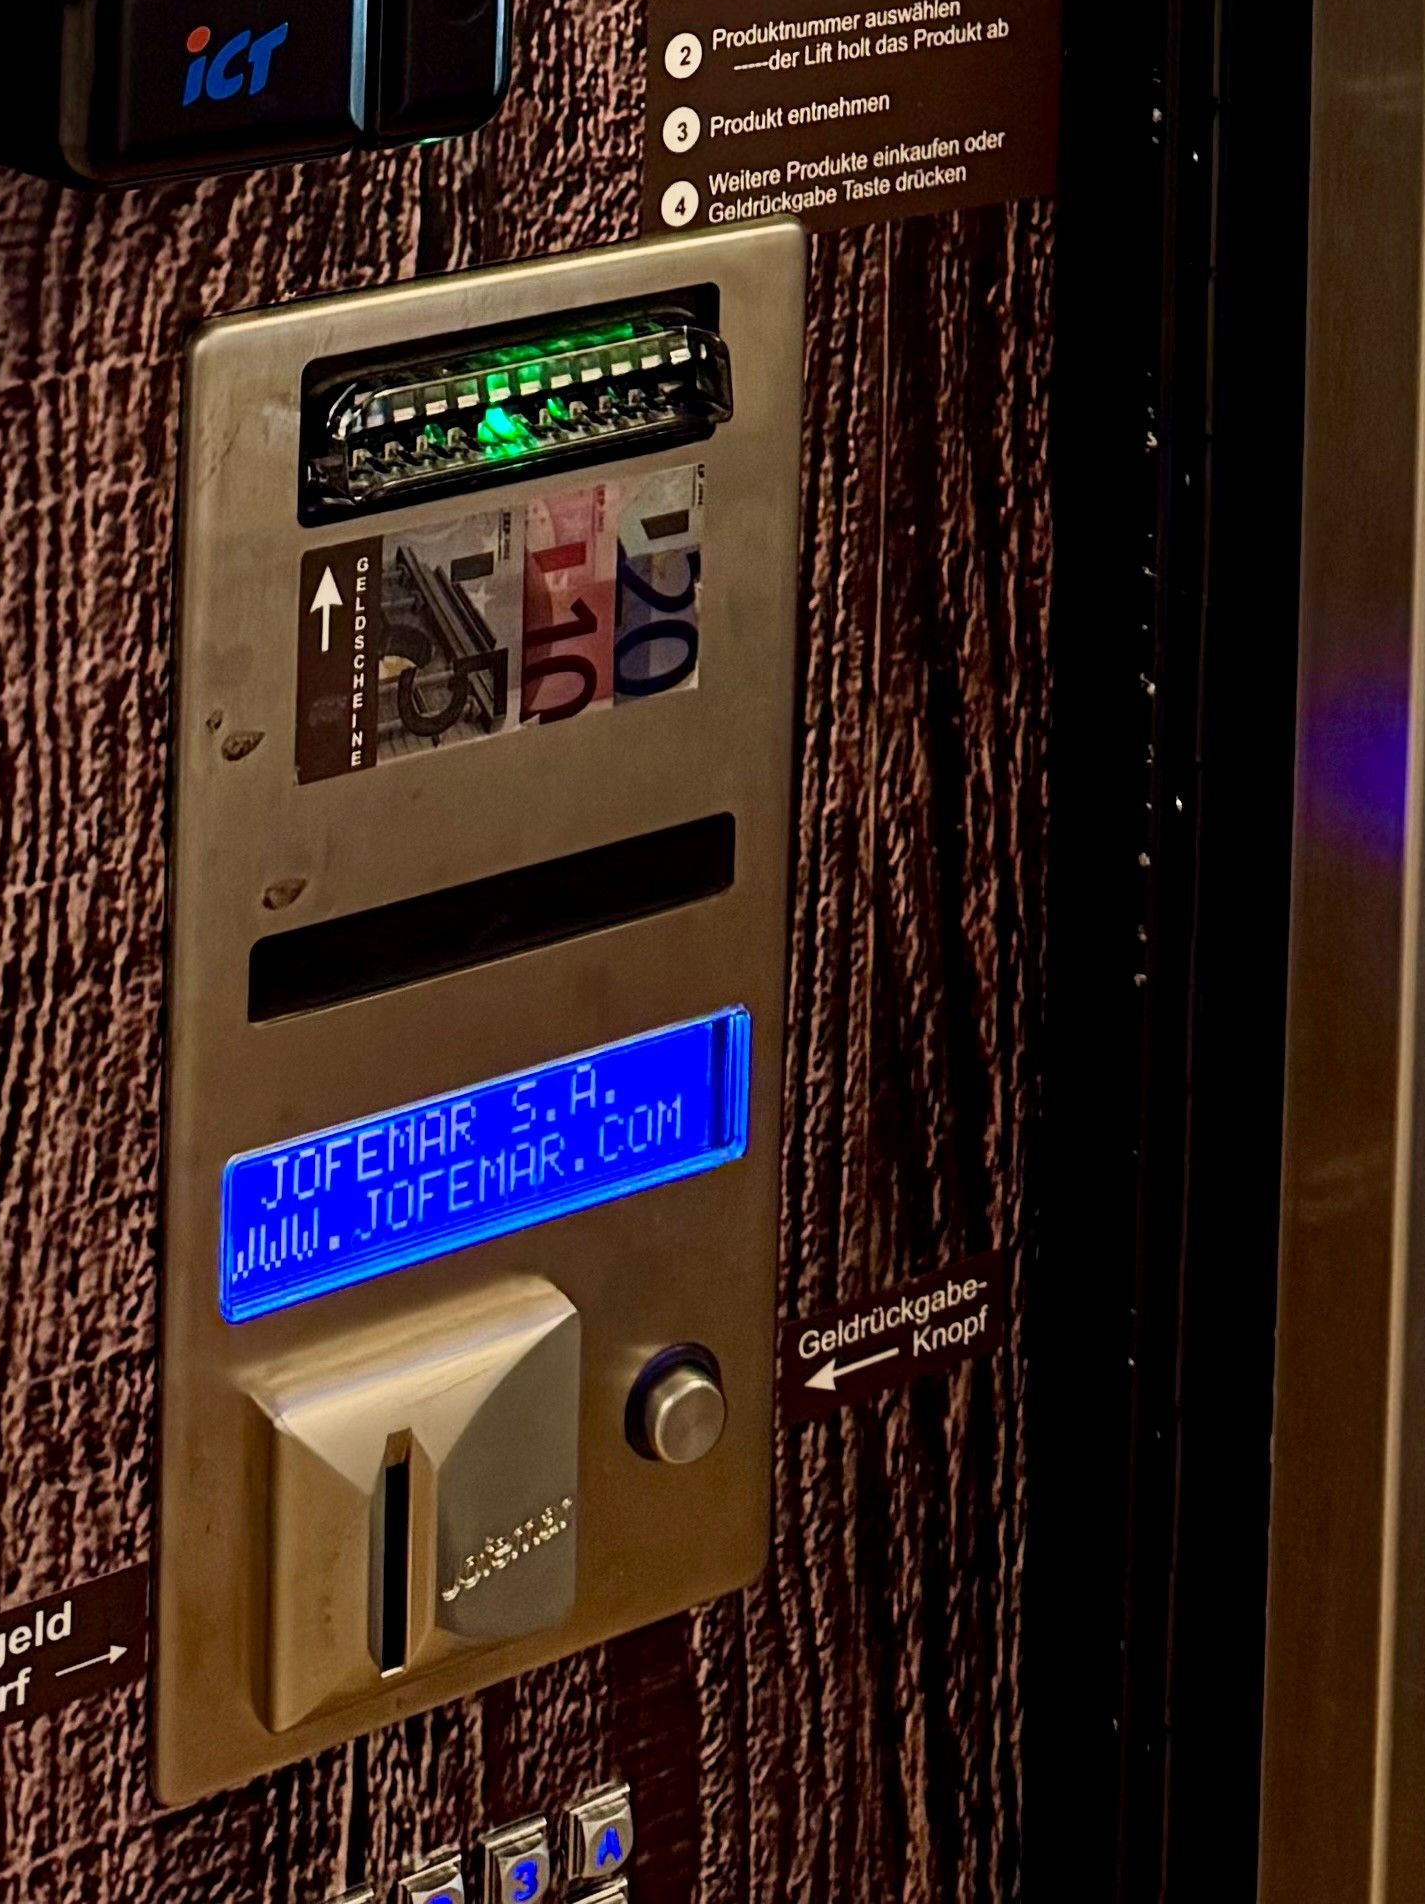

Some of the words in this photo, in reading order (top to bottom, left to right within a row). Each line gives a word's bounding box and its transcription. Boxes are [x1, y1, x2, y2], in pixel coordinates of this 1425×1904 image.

[712, 15, 861, 51] Produktnummer
[865, 0, 961, 30] auswählen
[804, 40, 833, 66] Lift
[838, 34, 872, 60] holt
[876, 31, 908, 55] das
[914, 22, 983, 50] Produkt
[987, 17, 1010, 39] ab
[709, 108, 784, 138] Produkt
[788, 93, 890, 125] entnehmen
[708, 168, 781, 197] Weitere
[786, 151, 868, 183] Produkte
[872, 136, 960, 169] einkaufen
[964, 130, 1005, 153] oder
[708, 188, 838, 224] Geldrückgabe
[842, 177, 891, 202] Taste
[895, 162, 967, 194] drücken
[349, 556, 369, 768] GELDSCHEINE
[260, 1102, 476, 1210] JOFEMAR
[511, 1063, 617, 1135] S.A.
[798, 1279, 988, 1360] Geldrückgabe-
[913, 1304, 988, 1357] Knopf
[512, 1858, 539, 1904] 3
